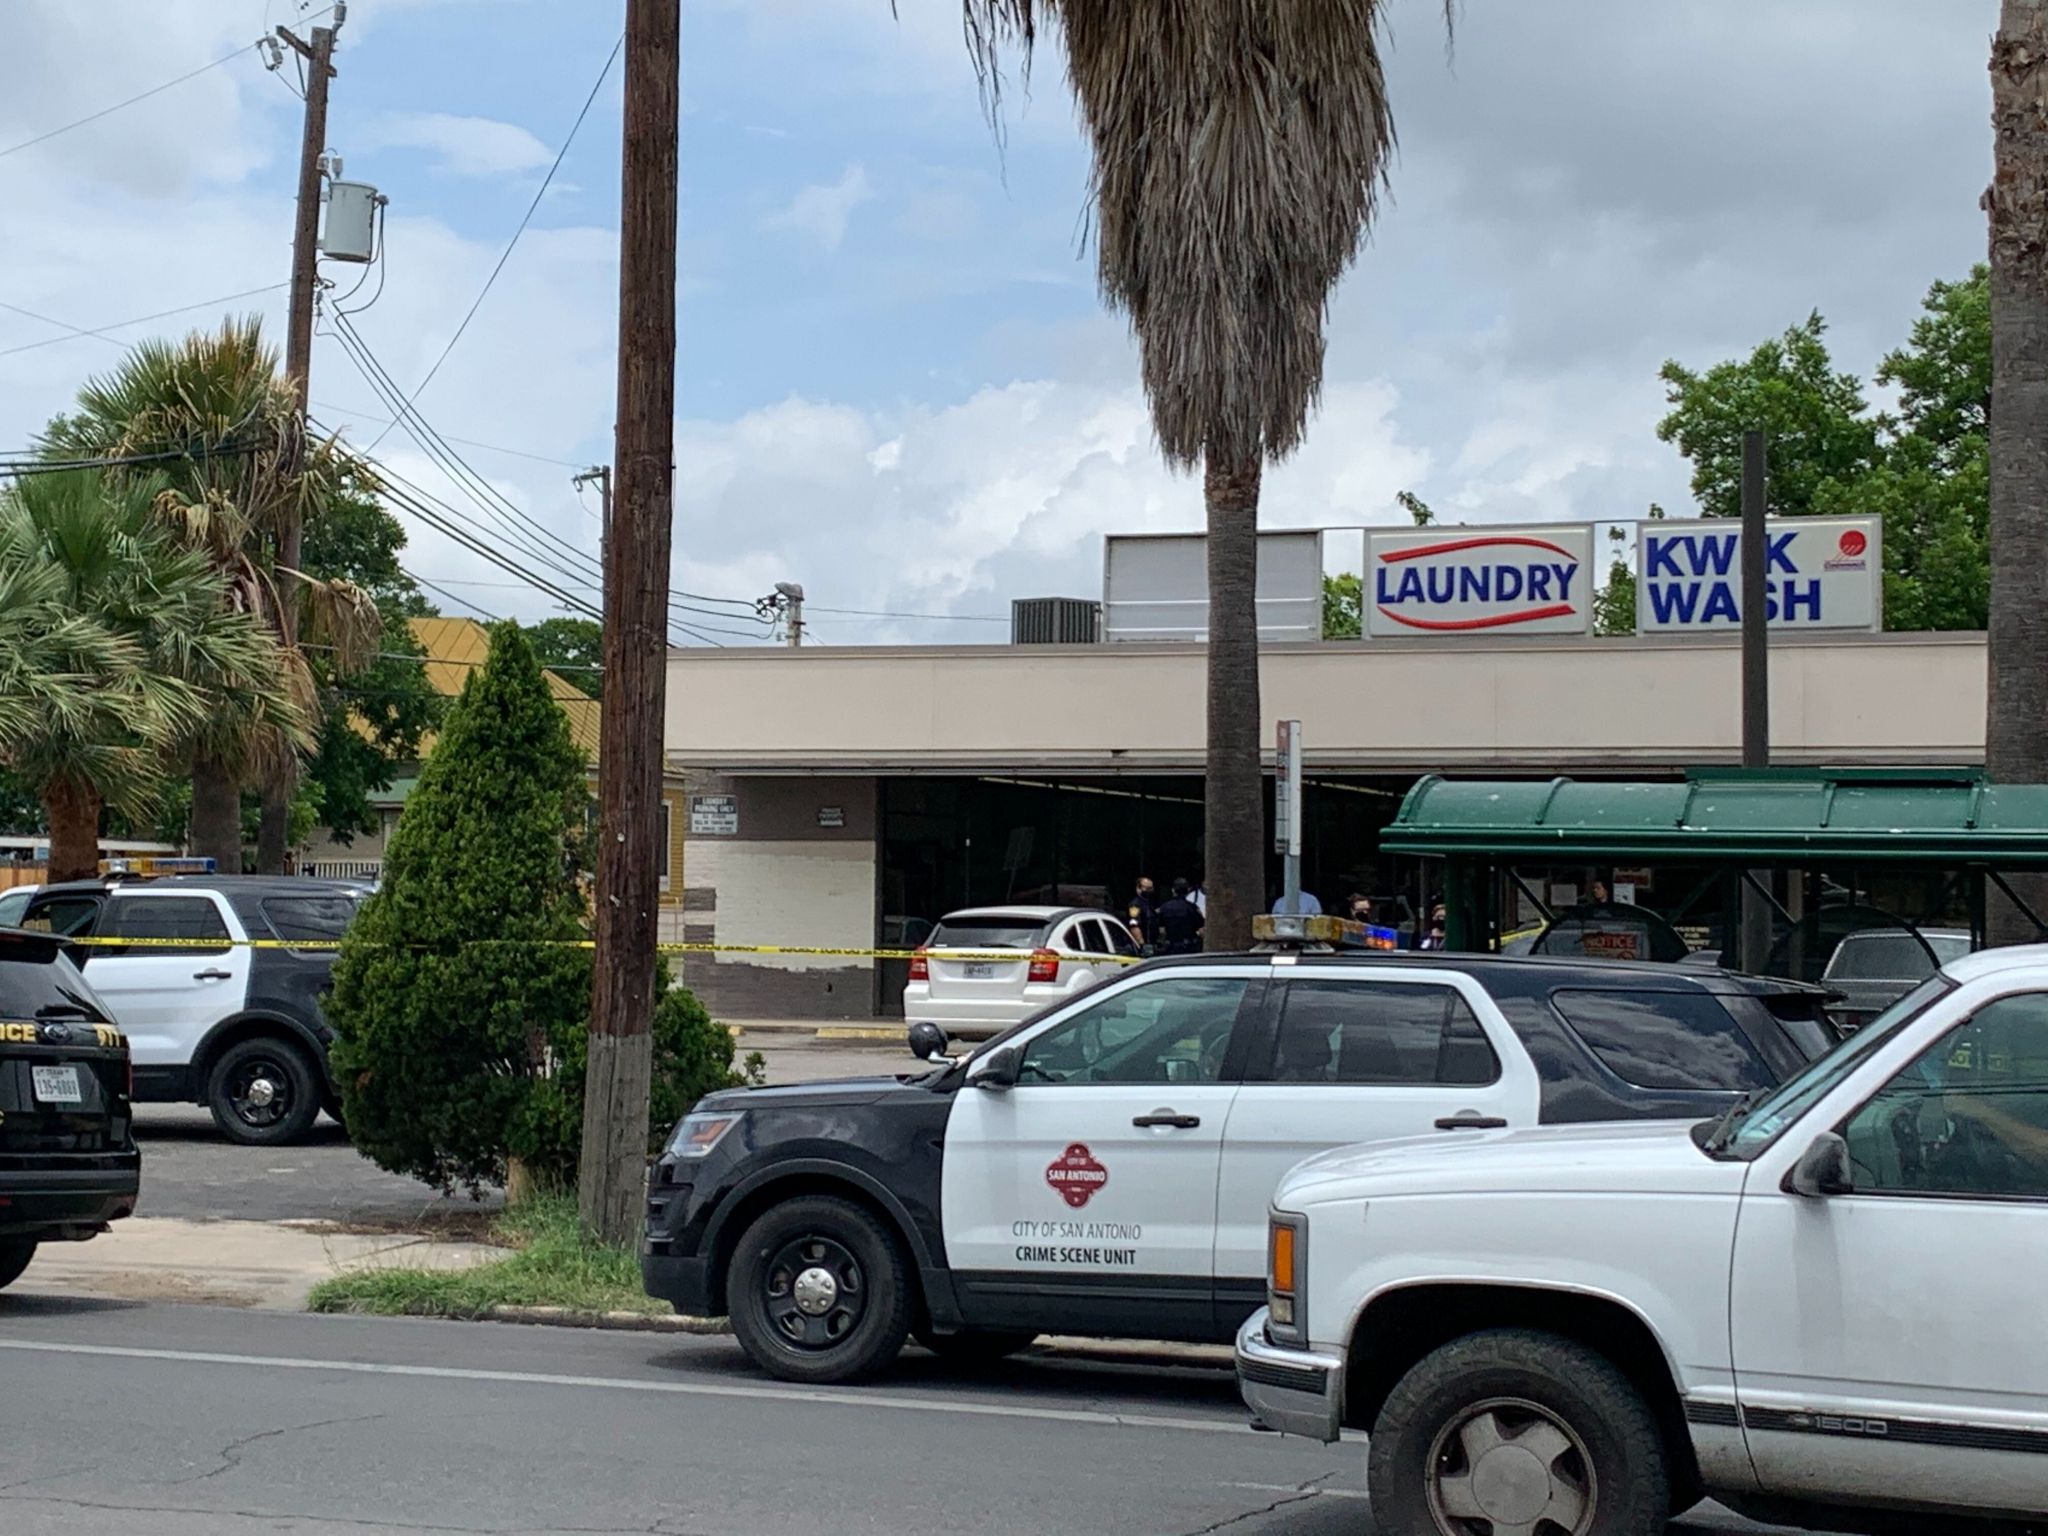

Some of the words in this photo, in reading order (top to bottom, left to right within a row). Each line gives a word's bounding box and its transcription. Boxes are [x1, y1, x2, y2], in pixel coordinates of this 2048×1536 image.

[1647, 531, 1799, 577] KWK
[1377, 563, 1579, 604] LAUNDRY
[95, 1026, 120, 1047] 911
[1048, 1169, 1066, 1180] SAN
[1066, 1169, 1105, 1182] ANTONIO
[1012, 1220, 1039, 1237] CITY
[1041, 1221, 1058, 1238] OF
[1060, 1222, 1084, 1238] SAN
[1086, 1223, 1141, 1240] ANTONIO
[1015, 1246, 1057, 1262] CRIME
[1060, 1247, 1101, 1264] SCENE
[1103, 1248, 1136, 1265] UNIT
[1815, 1415, 1888, 1434] 1500
